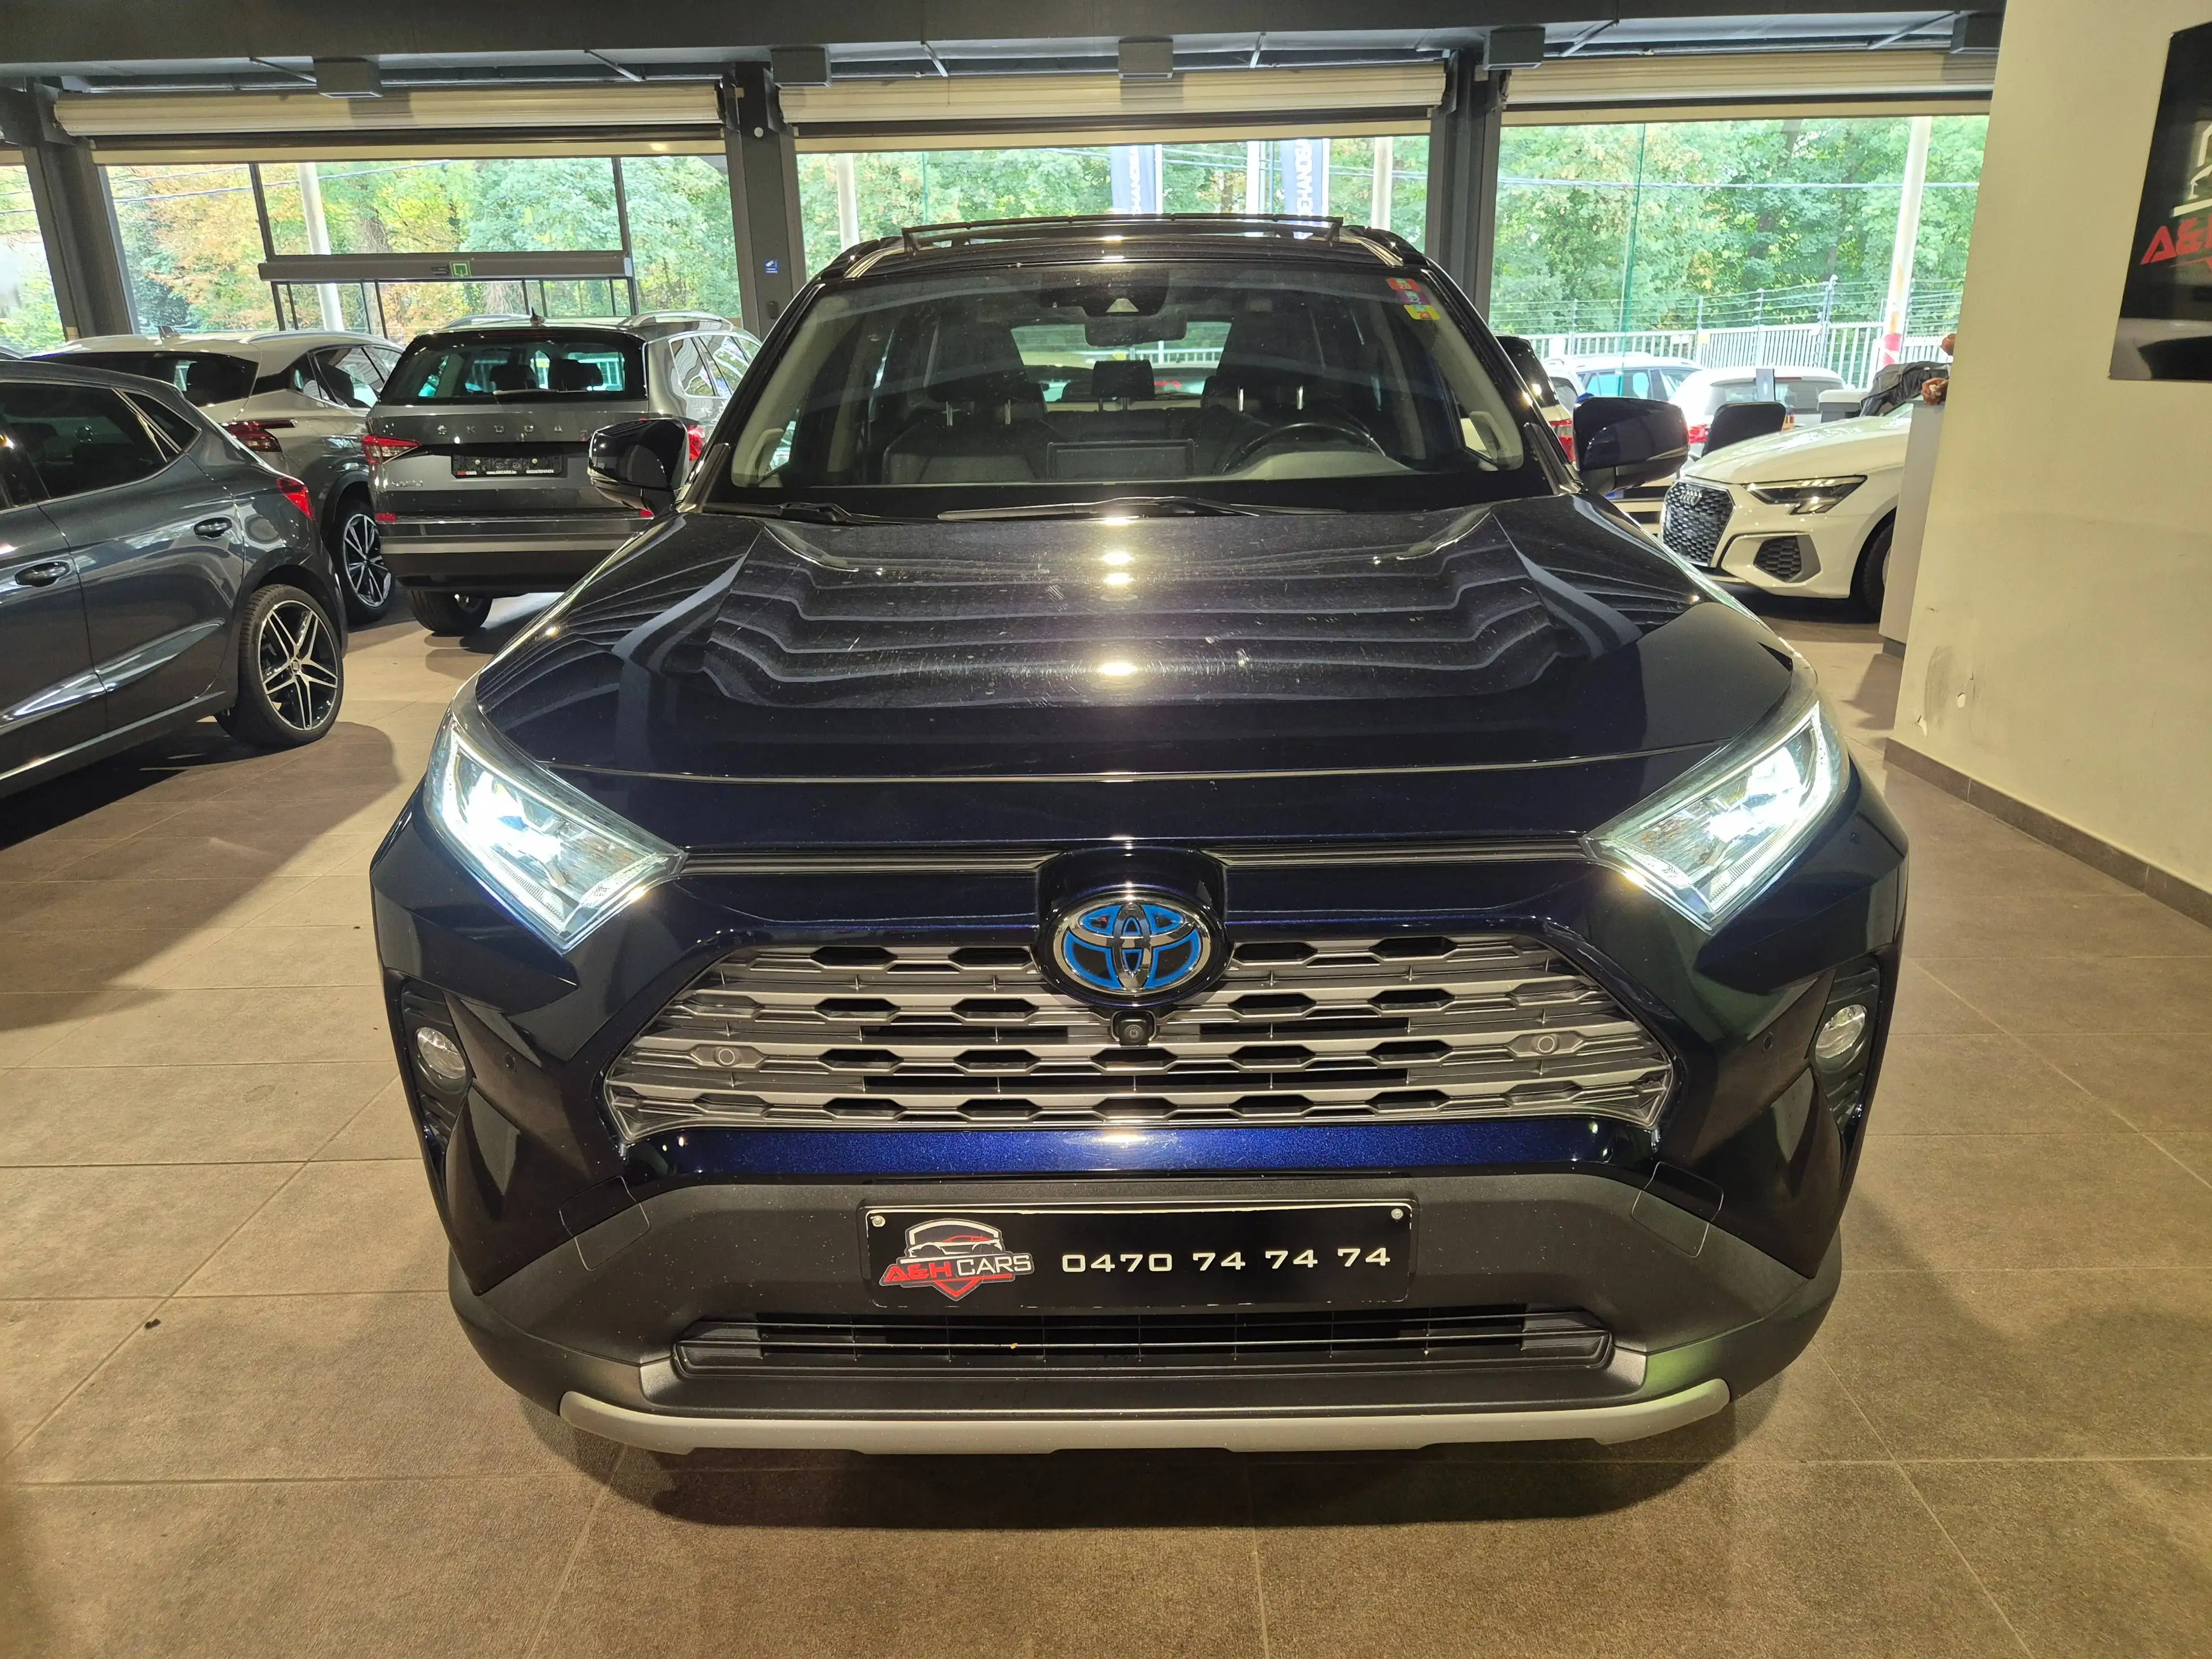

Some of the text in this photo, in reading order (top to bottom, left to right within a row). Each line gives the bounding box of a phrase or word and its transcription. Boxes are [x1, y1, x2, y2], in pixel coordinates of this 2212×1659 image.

[883, 1255, 1034, 1282] A&H CARS
[1062, 1247, 1391, 1272] 0470 74 74 74
